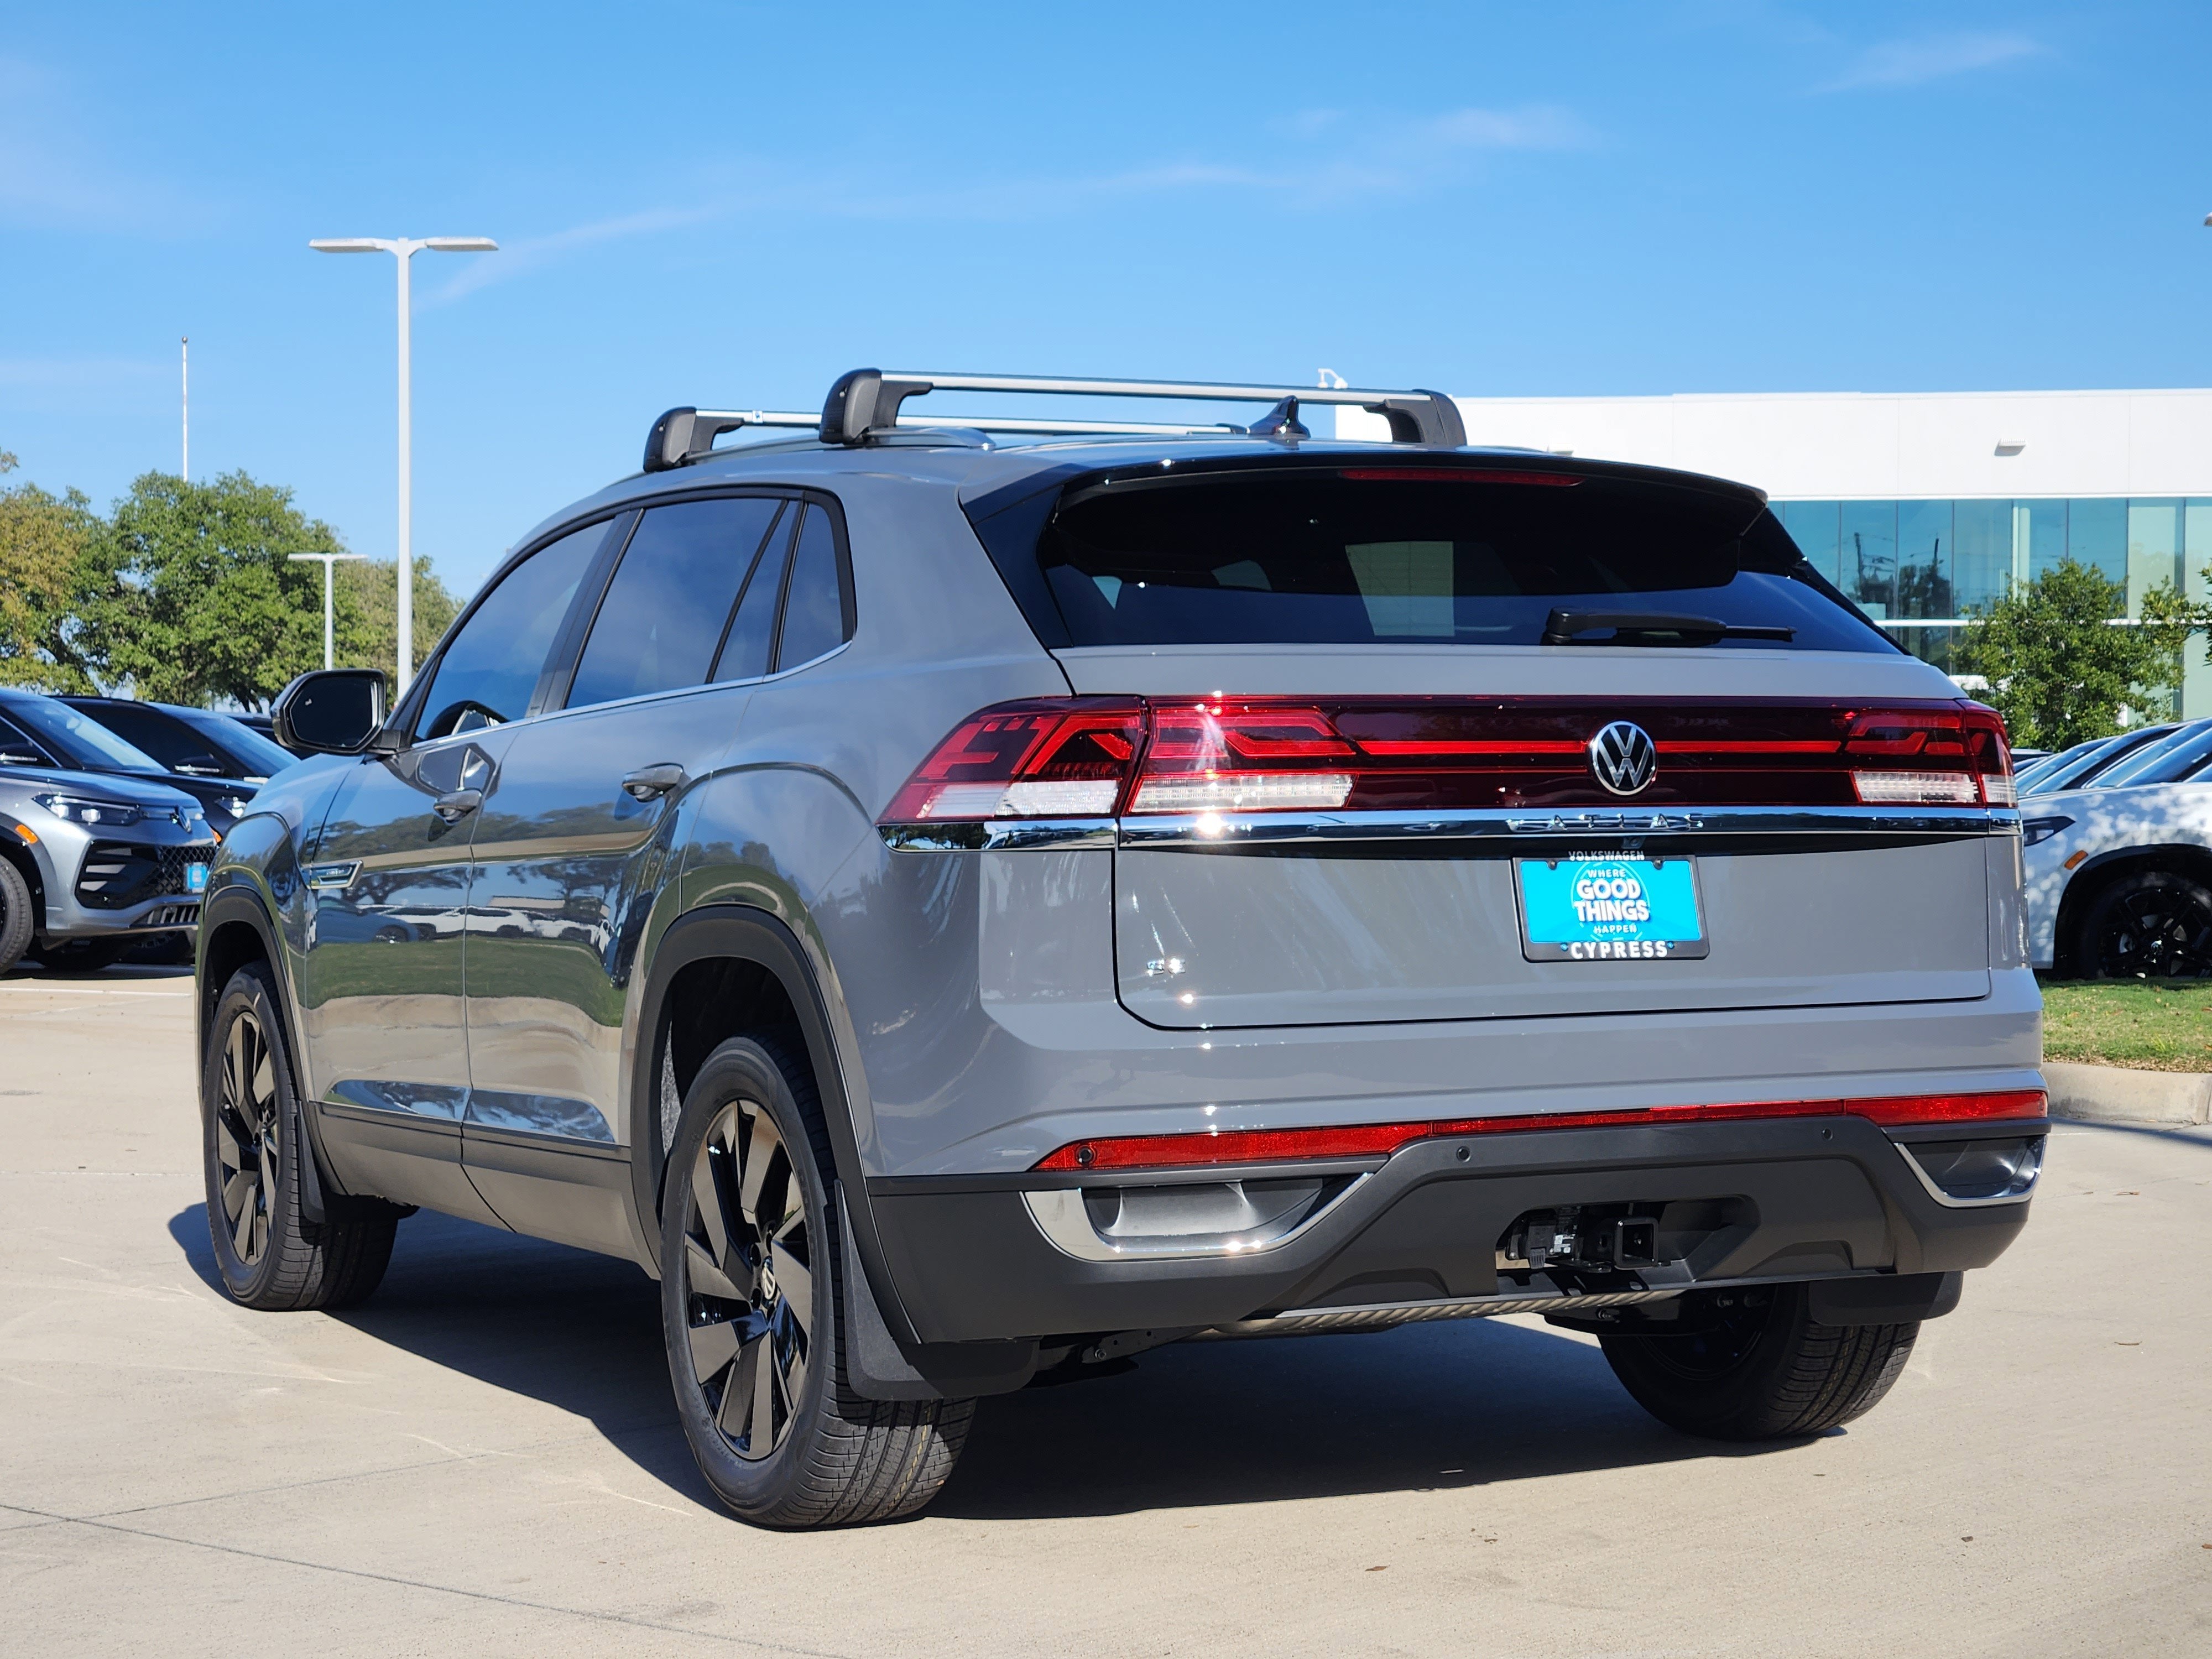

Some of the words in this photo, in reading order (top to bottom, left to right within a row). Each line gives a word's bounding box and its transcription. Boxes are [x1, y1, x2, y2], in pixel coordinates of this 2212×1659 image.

[1568, 851, 1645, 861] VOLKSWAGEN
[1587, 868, 1626, 878] WHERE
[1577, 878, 1641, 900] GOOD
[1573, 899, 1650, 922] THINGS
[1593, 924, 1637, 935] HAPPEN
[1571, 940, 1668, 959] CYPRESS
